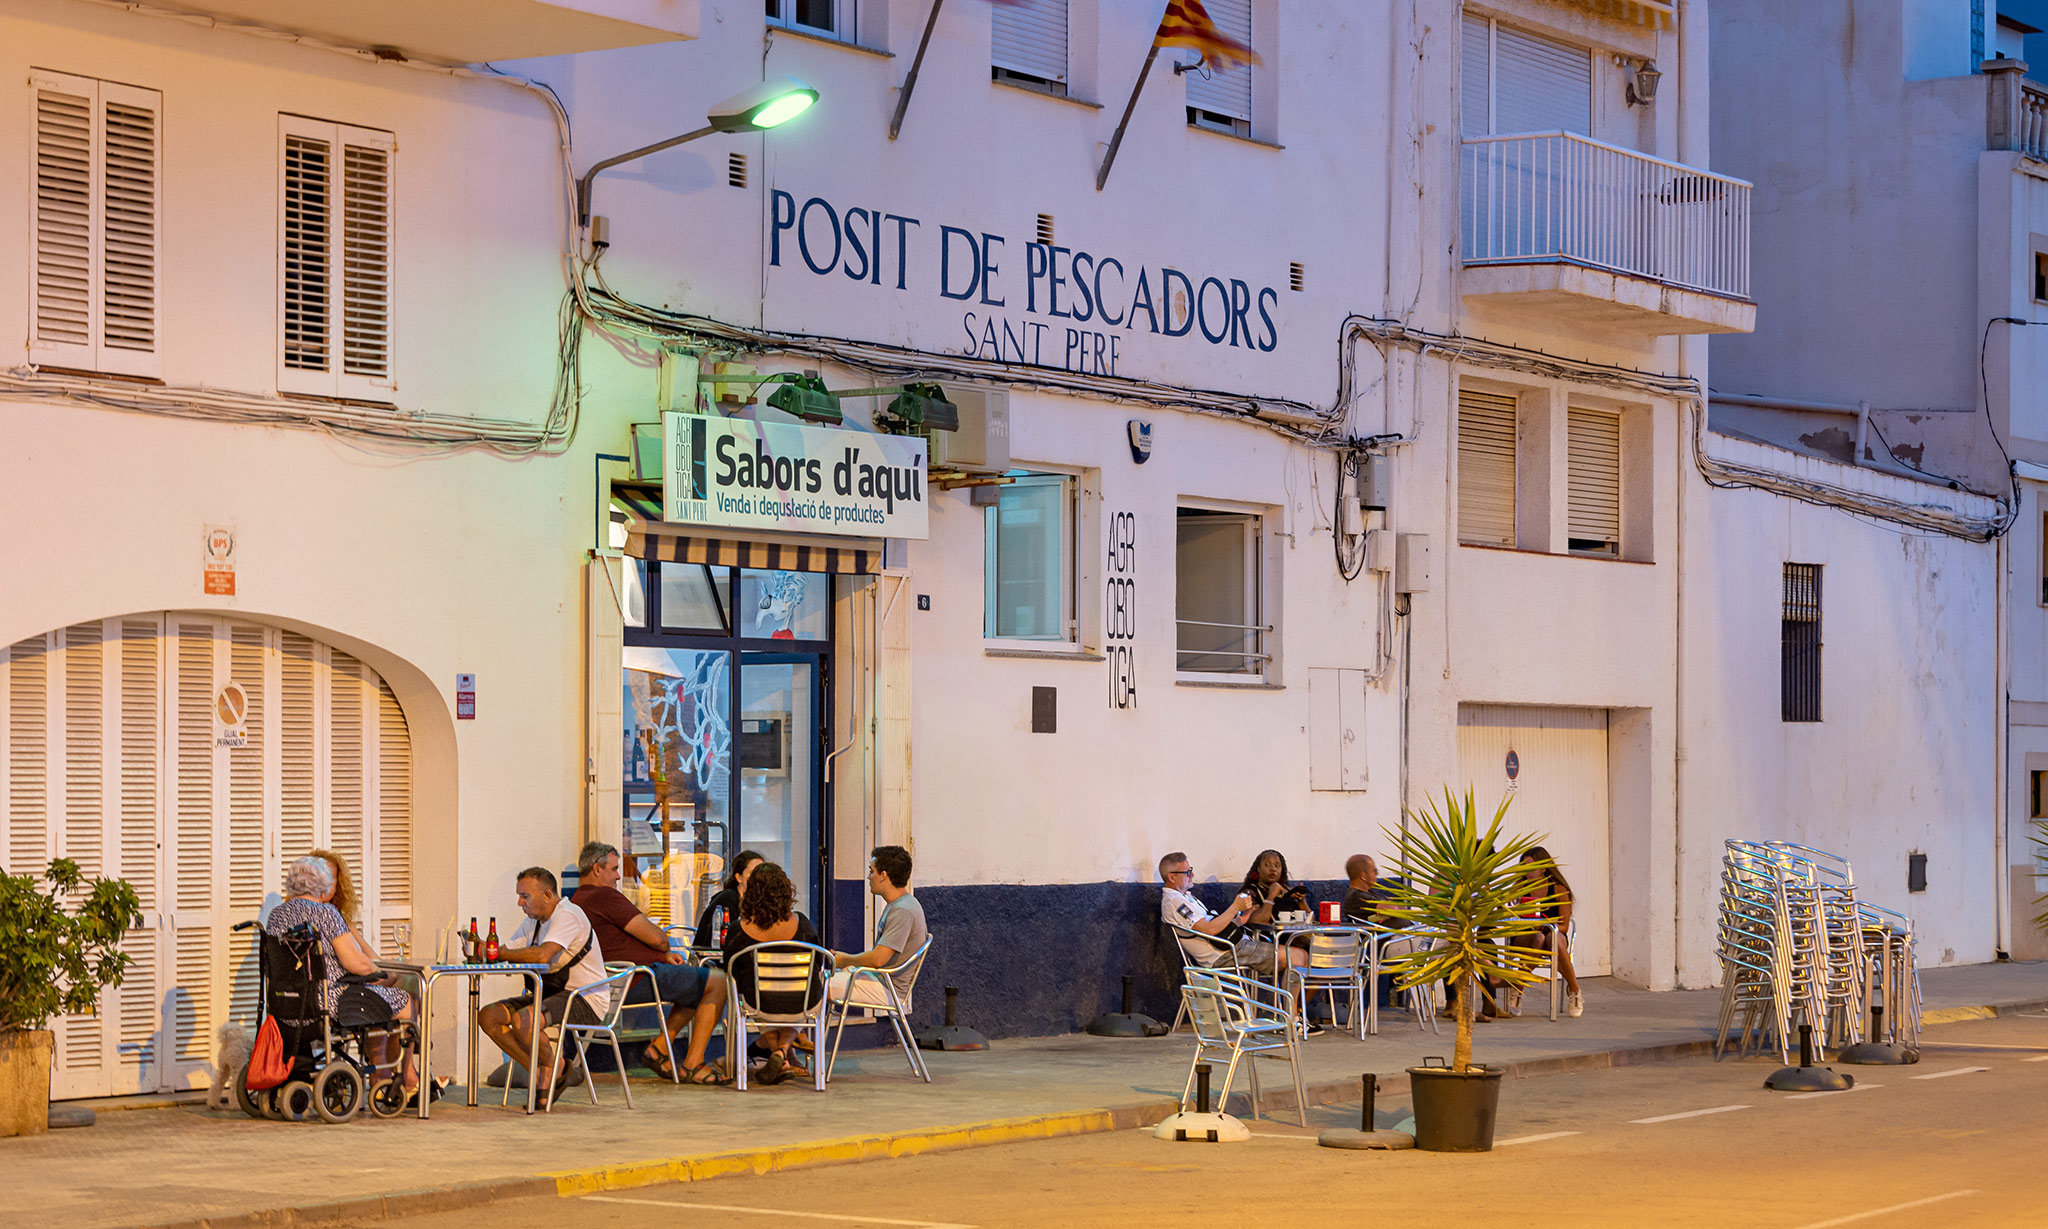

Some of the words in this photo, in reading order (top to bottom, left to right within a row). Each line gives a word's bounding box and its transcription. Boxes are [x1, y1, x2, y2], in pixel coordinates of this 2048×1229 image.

[769, 188, 920, 290] POSIT
[940, 225, 1005, 307] DE
[1025, 241, 1278, 352] PESCADORS
[963, 312, 1050, 365] SANT
[676, 416, 691, 444] AGR
[675, 443, 691, 472] OBO
[675, 472, 692, 500] TIGA
[715, 434, 822, 494] Sabors
[833, 447, 922, 515] d'aquí
[675, 501, 692, 520] SANT
[693, 502, 708, 521] PERE
[716, 491, 751, 514] Venda
[753, 494, 757, 514] i
[759, 495, 816, 521] degustació
[818, 500, 832, 520] de
[834, 502, 885, 526] productes
[213, 538, 227, 549] BPS
[1107, 511, 1136, 573] AGR
[921, 596, 927, 609] 6
[1106, 577, 1136, 640] OBO
[1106, 646, 1137, 709] TIGA
[216, 738, 245, 747] PERMANENT
